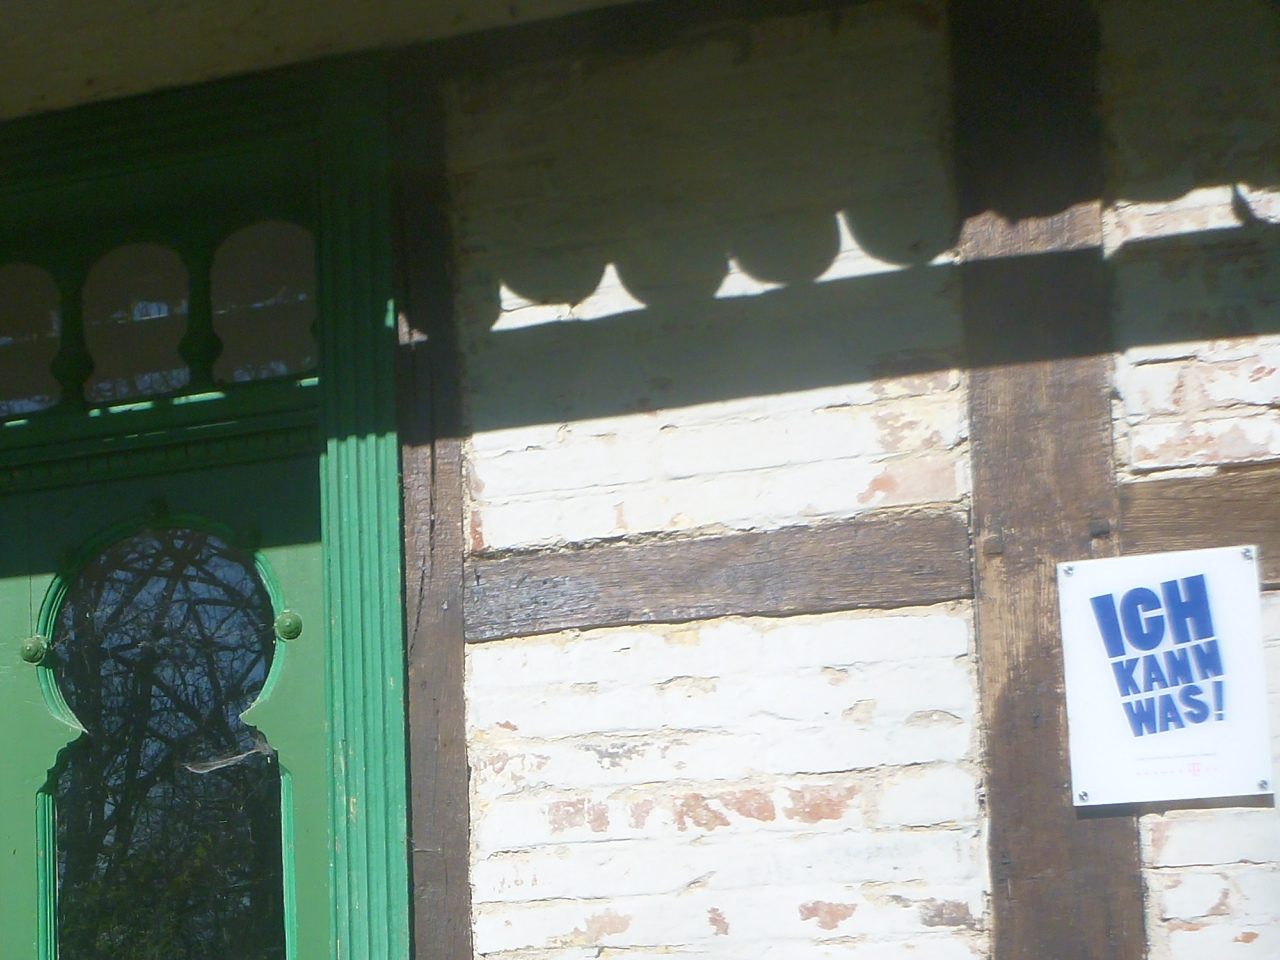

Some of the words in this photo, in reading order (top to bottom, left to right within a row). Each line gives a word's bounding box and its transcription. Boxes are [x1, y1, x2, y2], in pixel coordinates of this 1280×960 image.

[1089, 574, 1215, 658] ICH
[1111, 639, 1223, 697] KANN
[1122, 681, 1224, 737] WAS!
